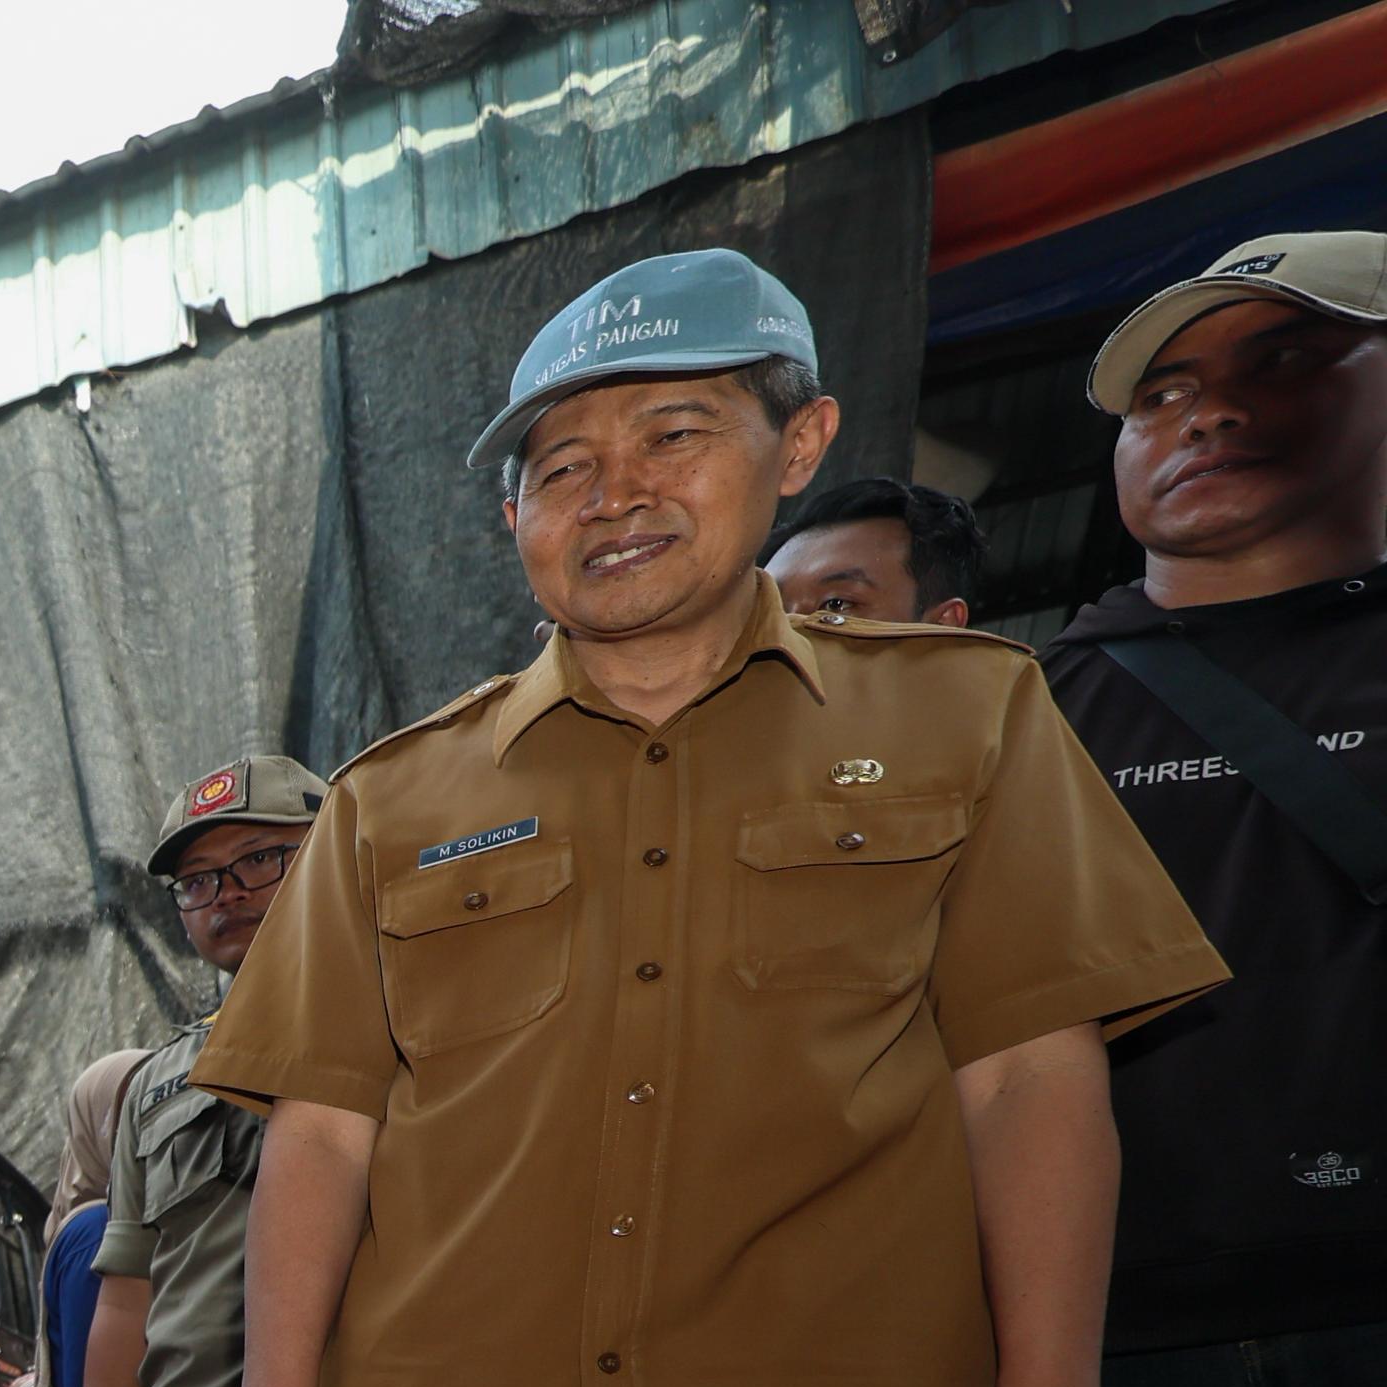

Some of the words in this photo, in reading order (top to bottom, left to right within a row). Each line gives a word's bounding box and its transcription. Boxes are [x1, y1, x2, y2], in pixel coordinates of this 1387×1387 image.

[567, 294, 642, 342] TIM
[534, 341, 587, 386] SATGAS
[595, 318, 680, 350] PANGAN
[439, 845, 454, 858] M.
[457, 826, 518, 852] SOLIKIN
